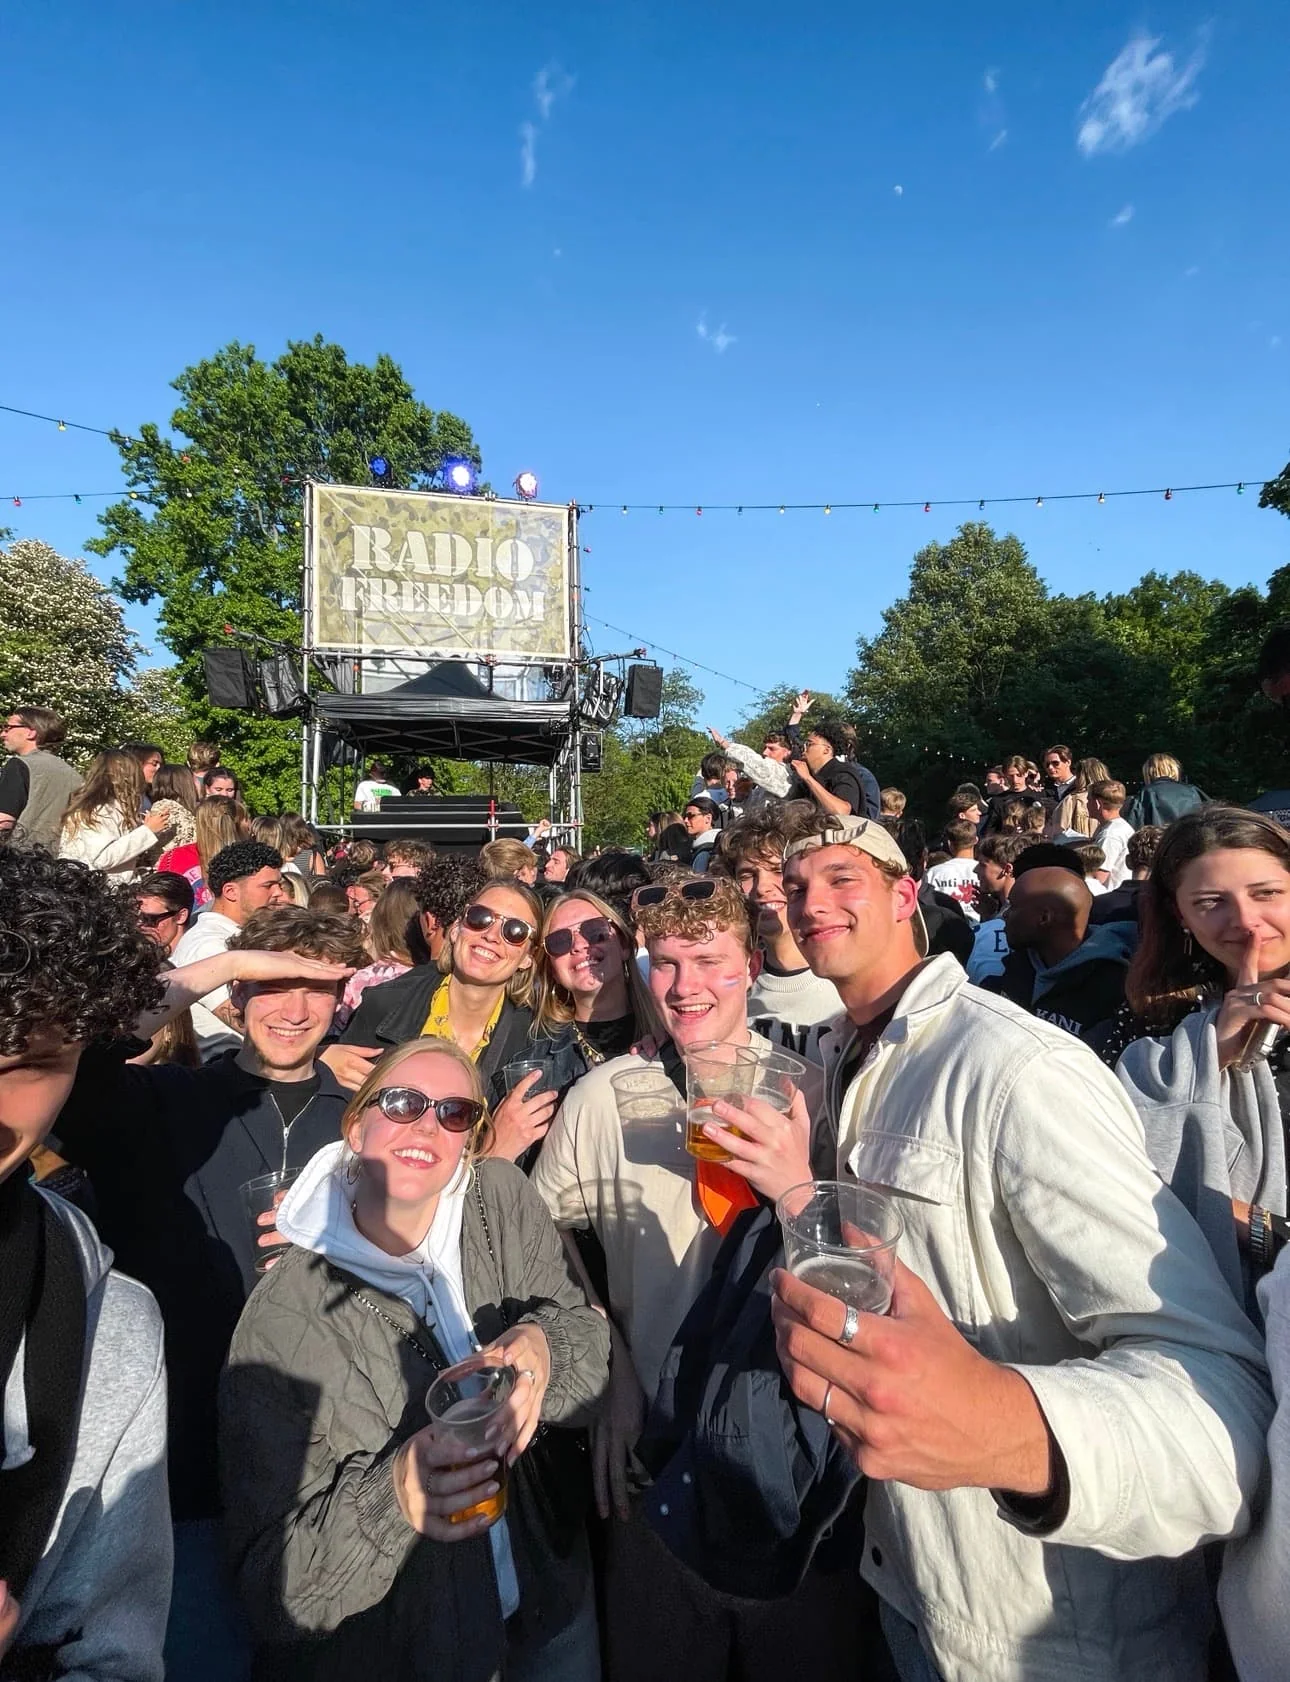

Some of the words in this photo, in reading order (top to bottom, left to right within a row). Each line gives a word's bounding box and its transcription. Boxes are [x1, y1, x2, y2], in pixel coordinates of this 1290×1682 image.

[350, 525, 535, 582] RADIO
[340, 576, 546, 623] FREEDOM
[1036, 1008, 1083, 1035] KANI
